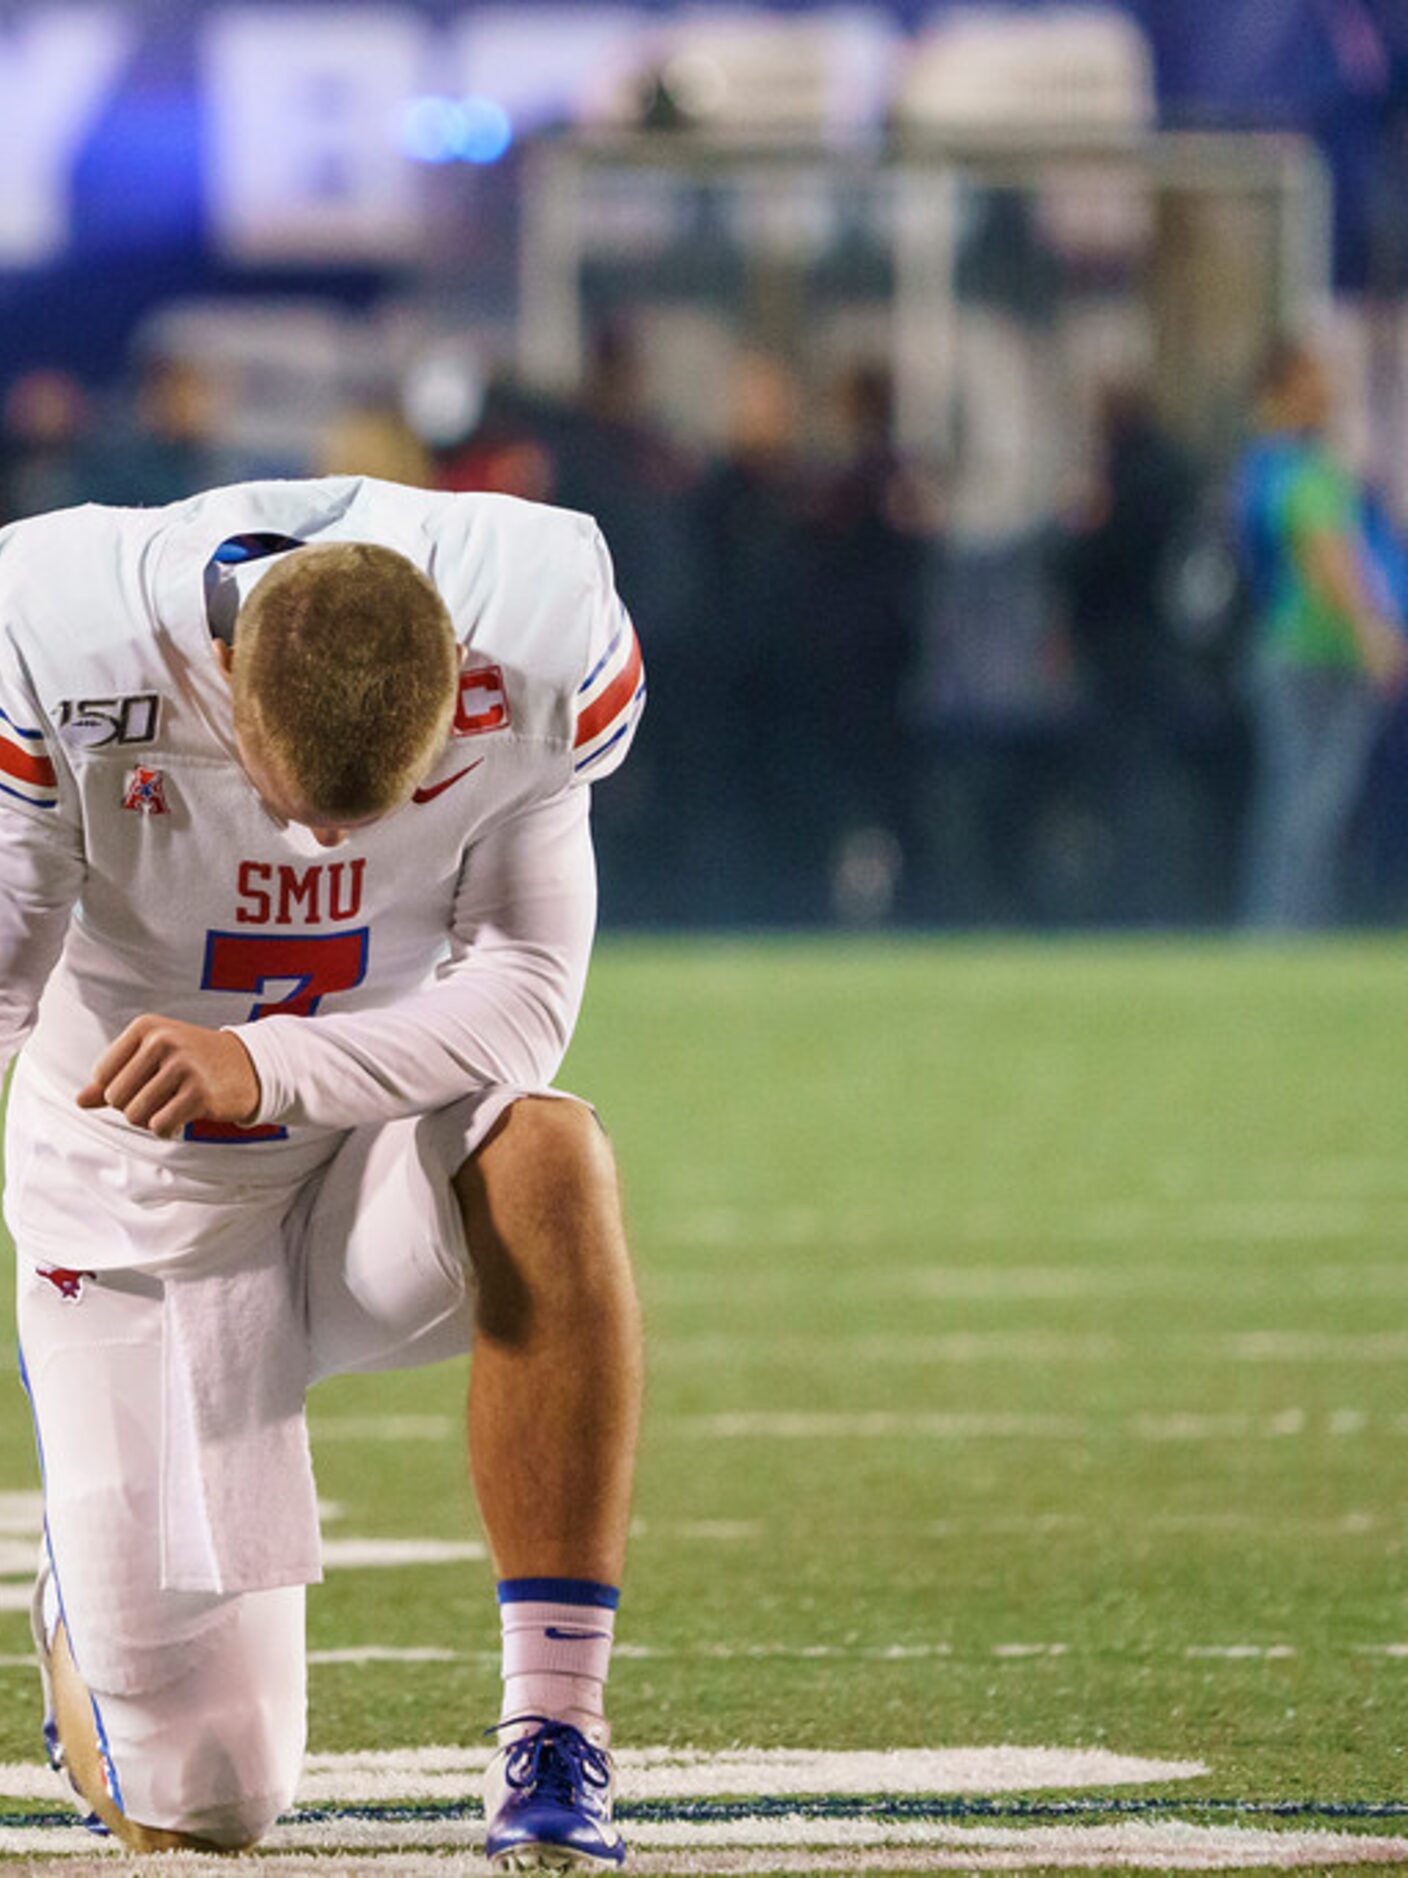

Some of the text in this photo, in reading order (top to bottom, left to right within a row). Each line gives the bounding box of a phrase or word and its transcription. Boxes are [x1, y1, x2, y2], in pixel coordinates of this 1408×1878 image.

[58, 694, 158, 748] 150
[453, 670, 505, 732] C
[235, 858, 366, 925] SMU
[180, 926, 369, 1143] 7
